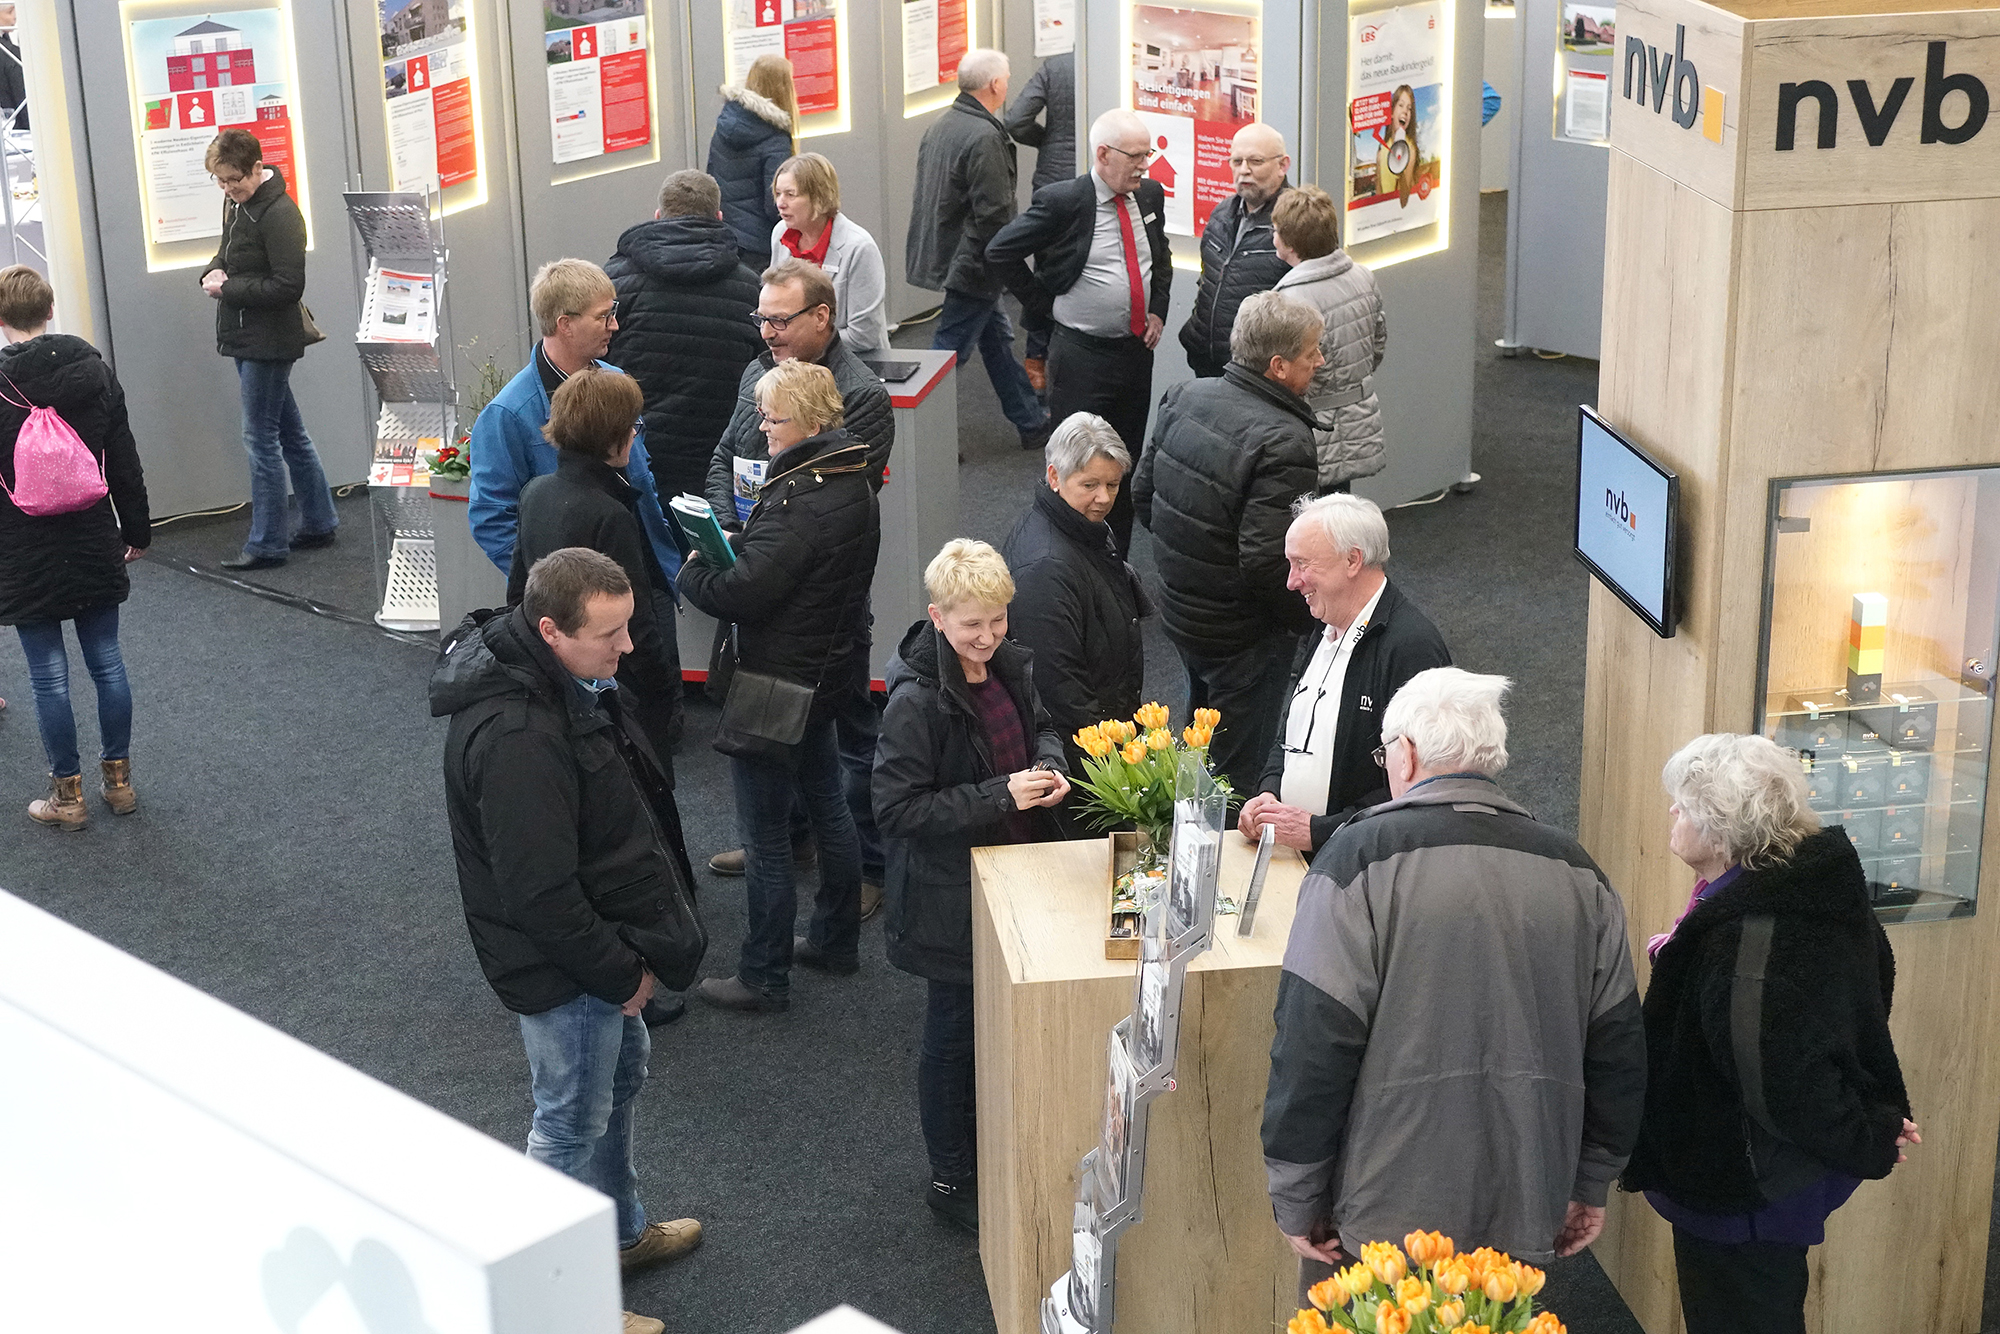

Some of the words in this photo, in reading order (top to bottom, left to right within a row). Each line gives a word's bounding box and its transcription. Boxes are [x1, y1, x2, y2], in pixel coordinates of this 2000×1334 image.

[1361, 31, 1376, 43] LBS
[1361, 57, 1372, 67] Her
[1361, 71, 1372, 81] das
[1373, 68, 1389, 78] neue
[1623, 23, 1699, 130] nvb
[1138, 80, 1211, 100] Besichtigungen
[1775, 41, 1990, 151] nvb
[1138, 95, 1159, 108] sind
[1160, 98, 1197, 113] einfach.
[1197, 134, 1215, 142] Haben
[1606, 487, 1629, 523] nvb
[1353, 624, 1366, 643] nvb
